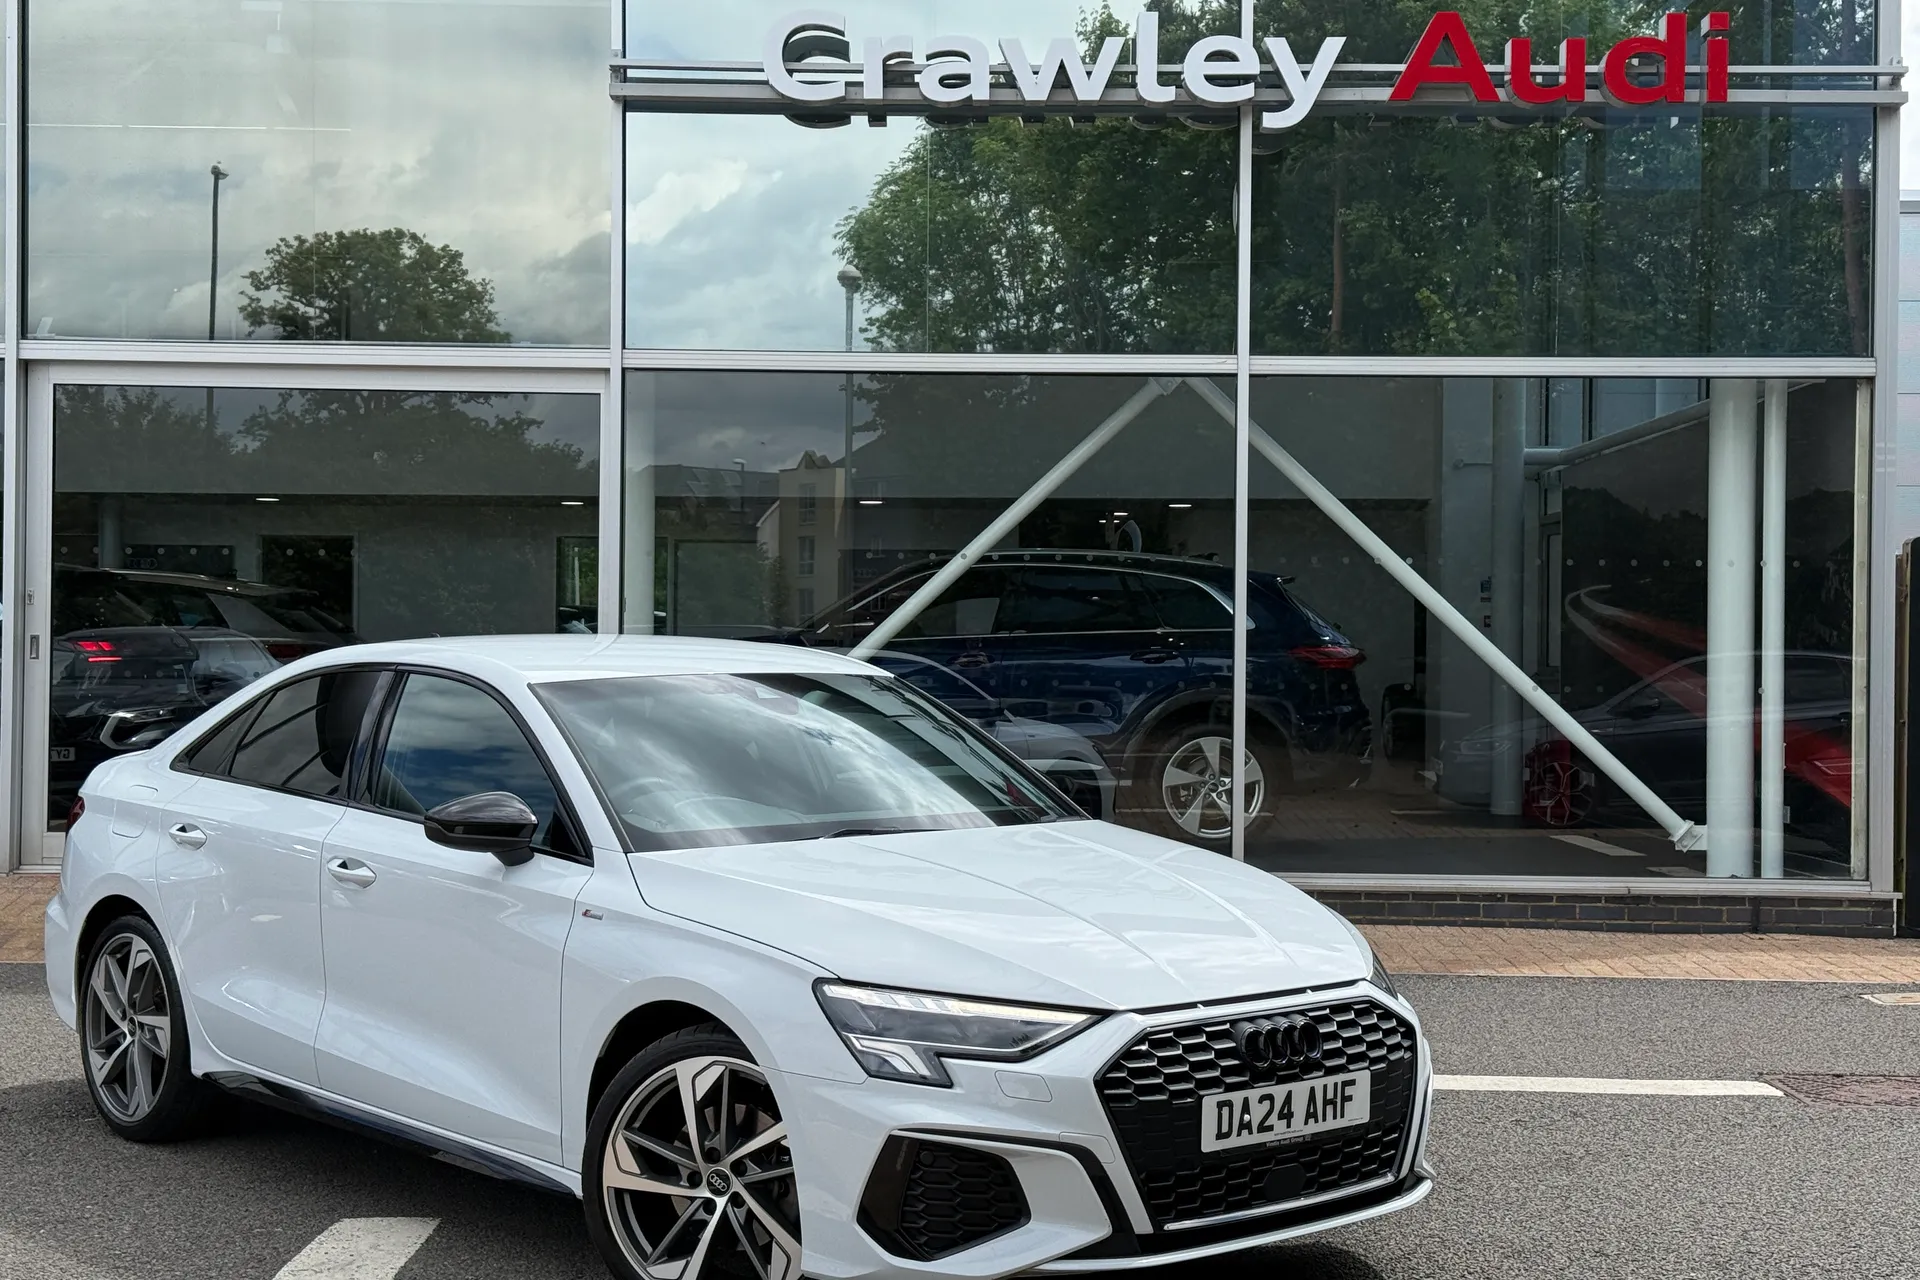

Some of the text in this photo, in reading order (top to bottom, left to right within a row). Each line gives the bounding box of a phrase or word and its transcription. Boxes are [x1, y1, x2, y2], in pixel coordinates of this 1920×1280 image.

[762, 9, 1729, 128] Crawley Audi
[1215, 1079, 1357, 1140] DA24 AHF
